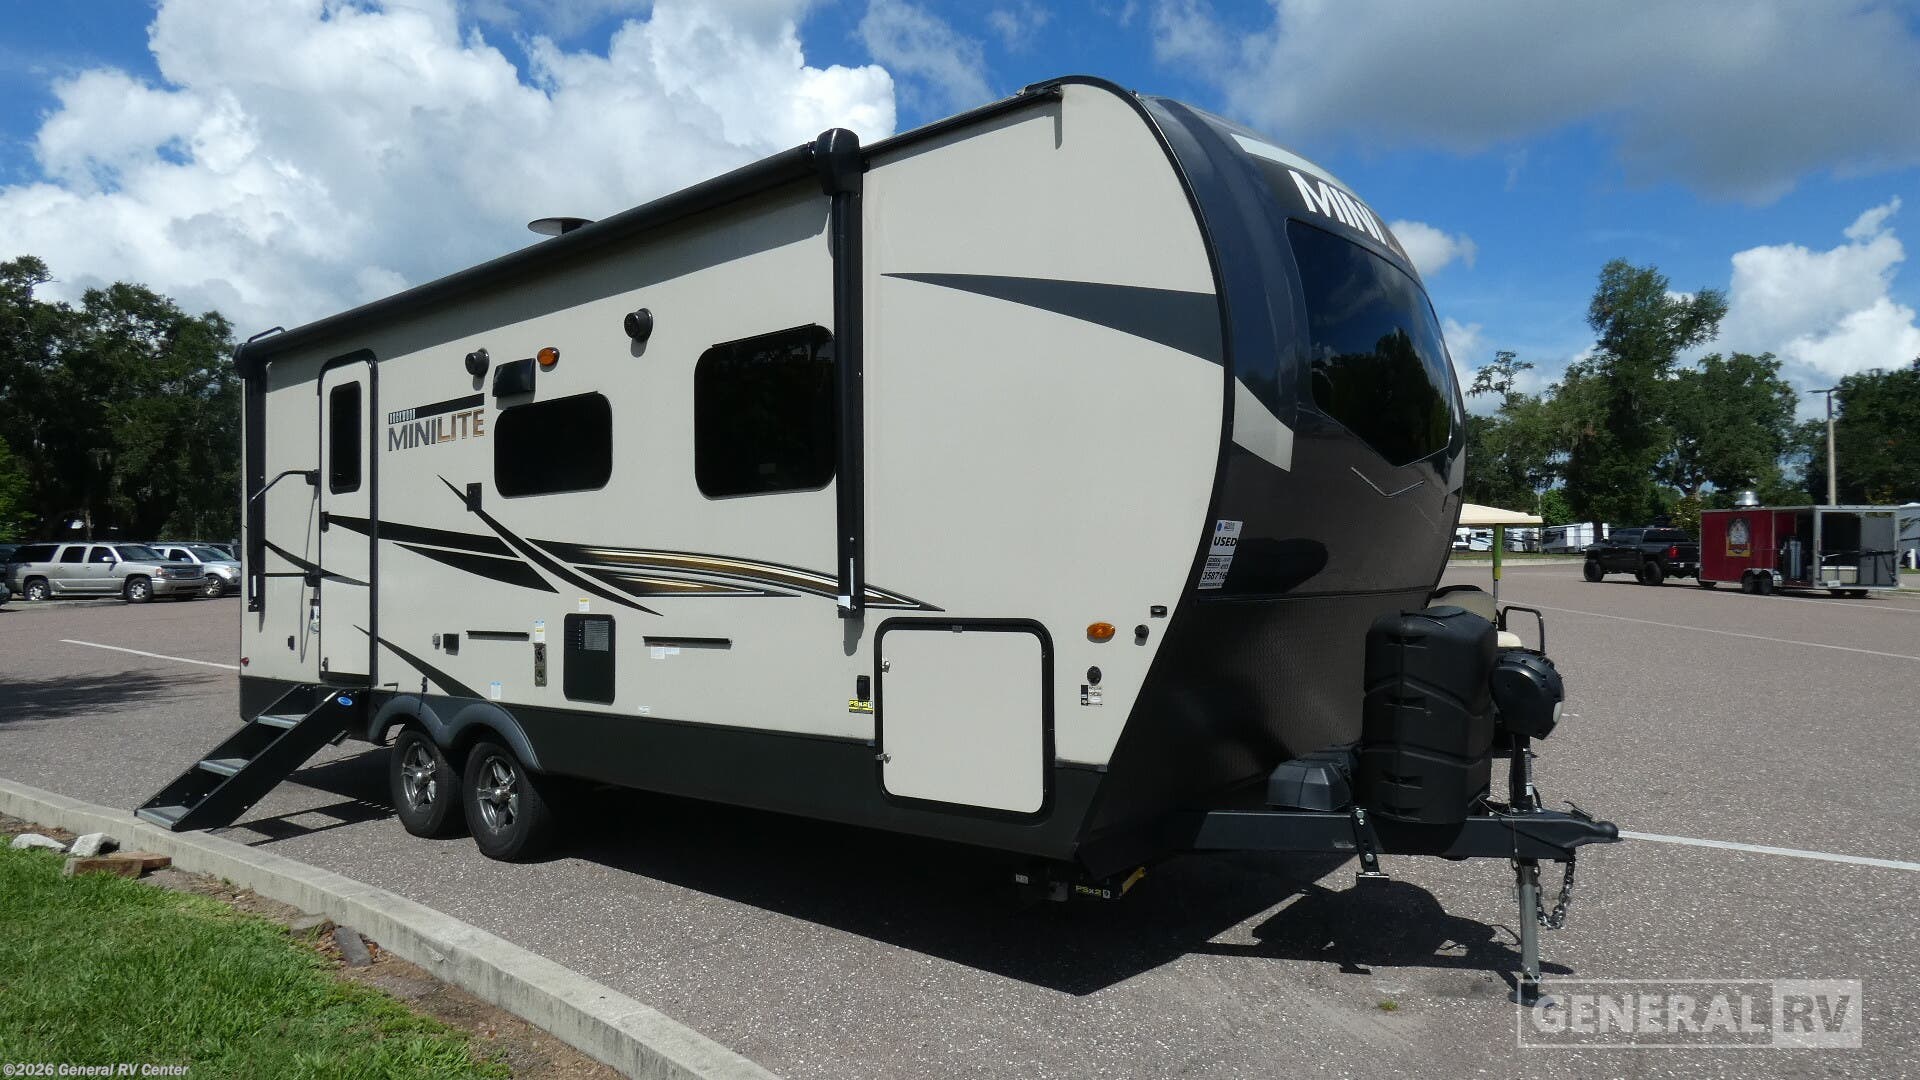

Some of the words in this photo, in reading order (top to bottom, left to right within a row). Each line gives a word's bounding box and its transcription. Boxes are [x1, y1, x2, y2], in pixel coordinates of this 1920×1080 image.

[1288, 169, 1387, 246] MINI
[388, 408, 485, 452] MINILITE
[1213, 536, 1237, 547] USED
